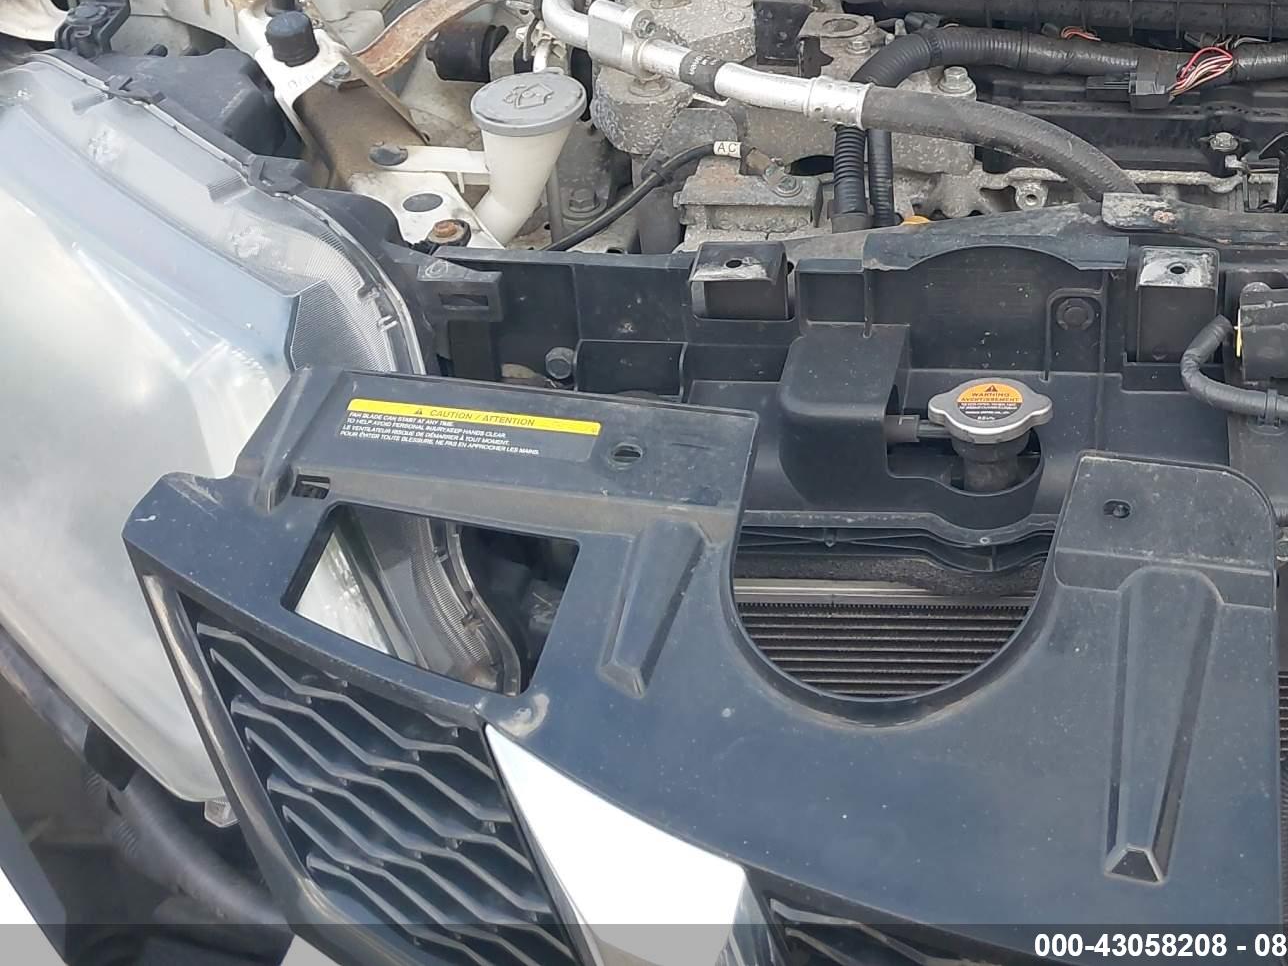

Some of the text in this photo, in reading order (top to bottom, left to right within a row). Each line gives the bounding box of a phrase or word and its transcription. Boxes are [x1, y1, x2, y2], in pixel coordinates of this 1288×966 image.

[717, 142, 737, 153] AC
[430, 409, 473, 420] CAUTION
[482, 415, 535, 426] ATTENTION
[351, 425, 391, 433] VENTILATEUR
[391, 422, 424, 430] PERSONAL
